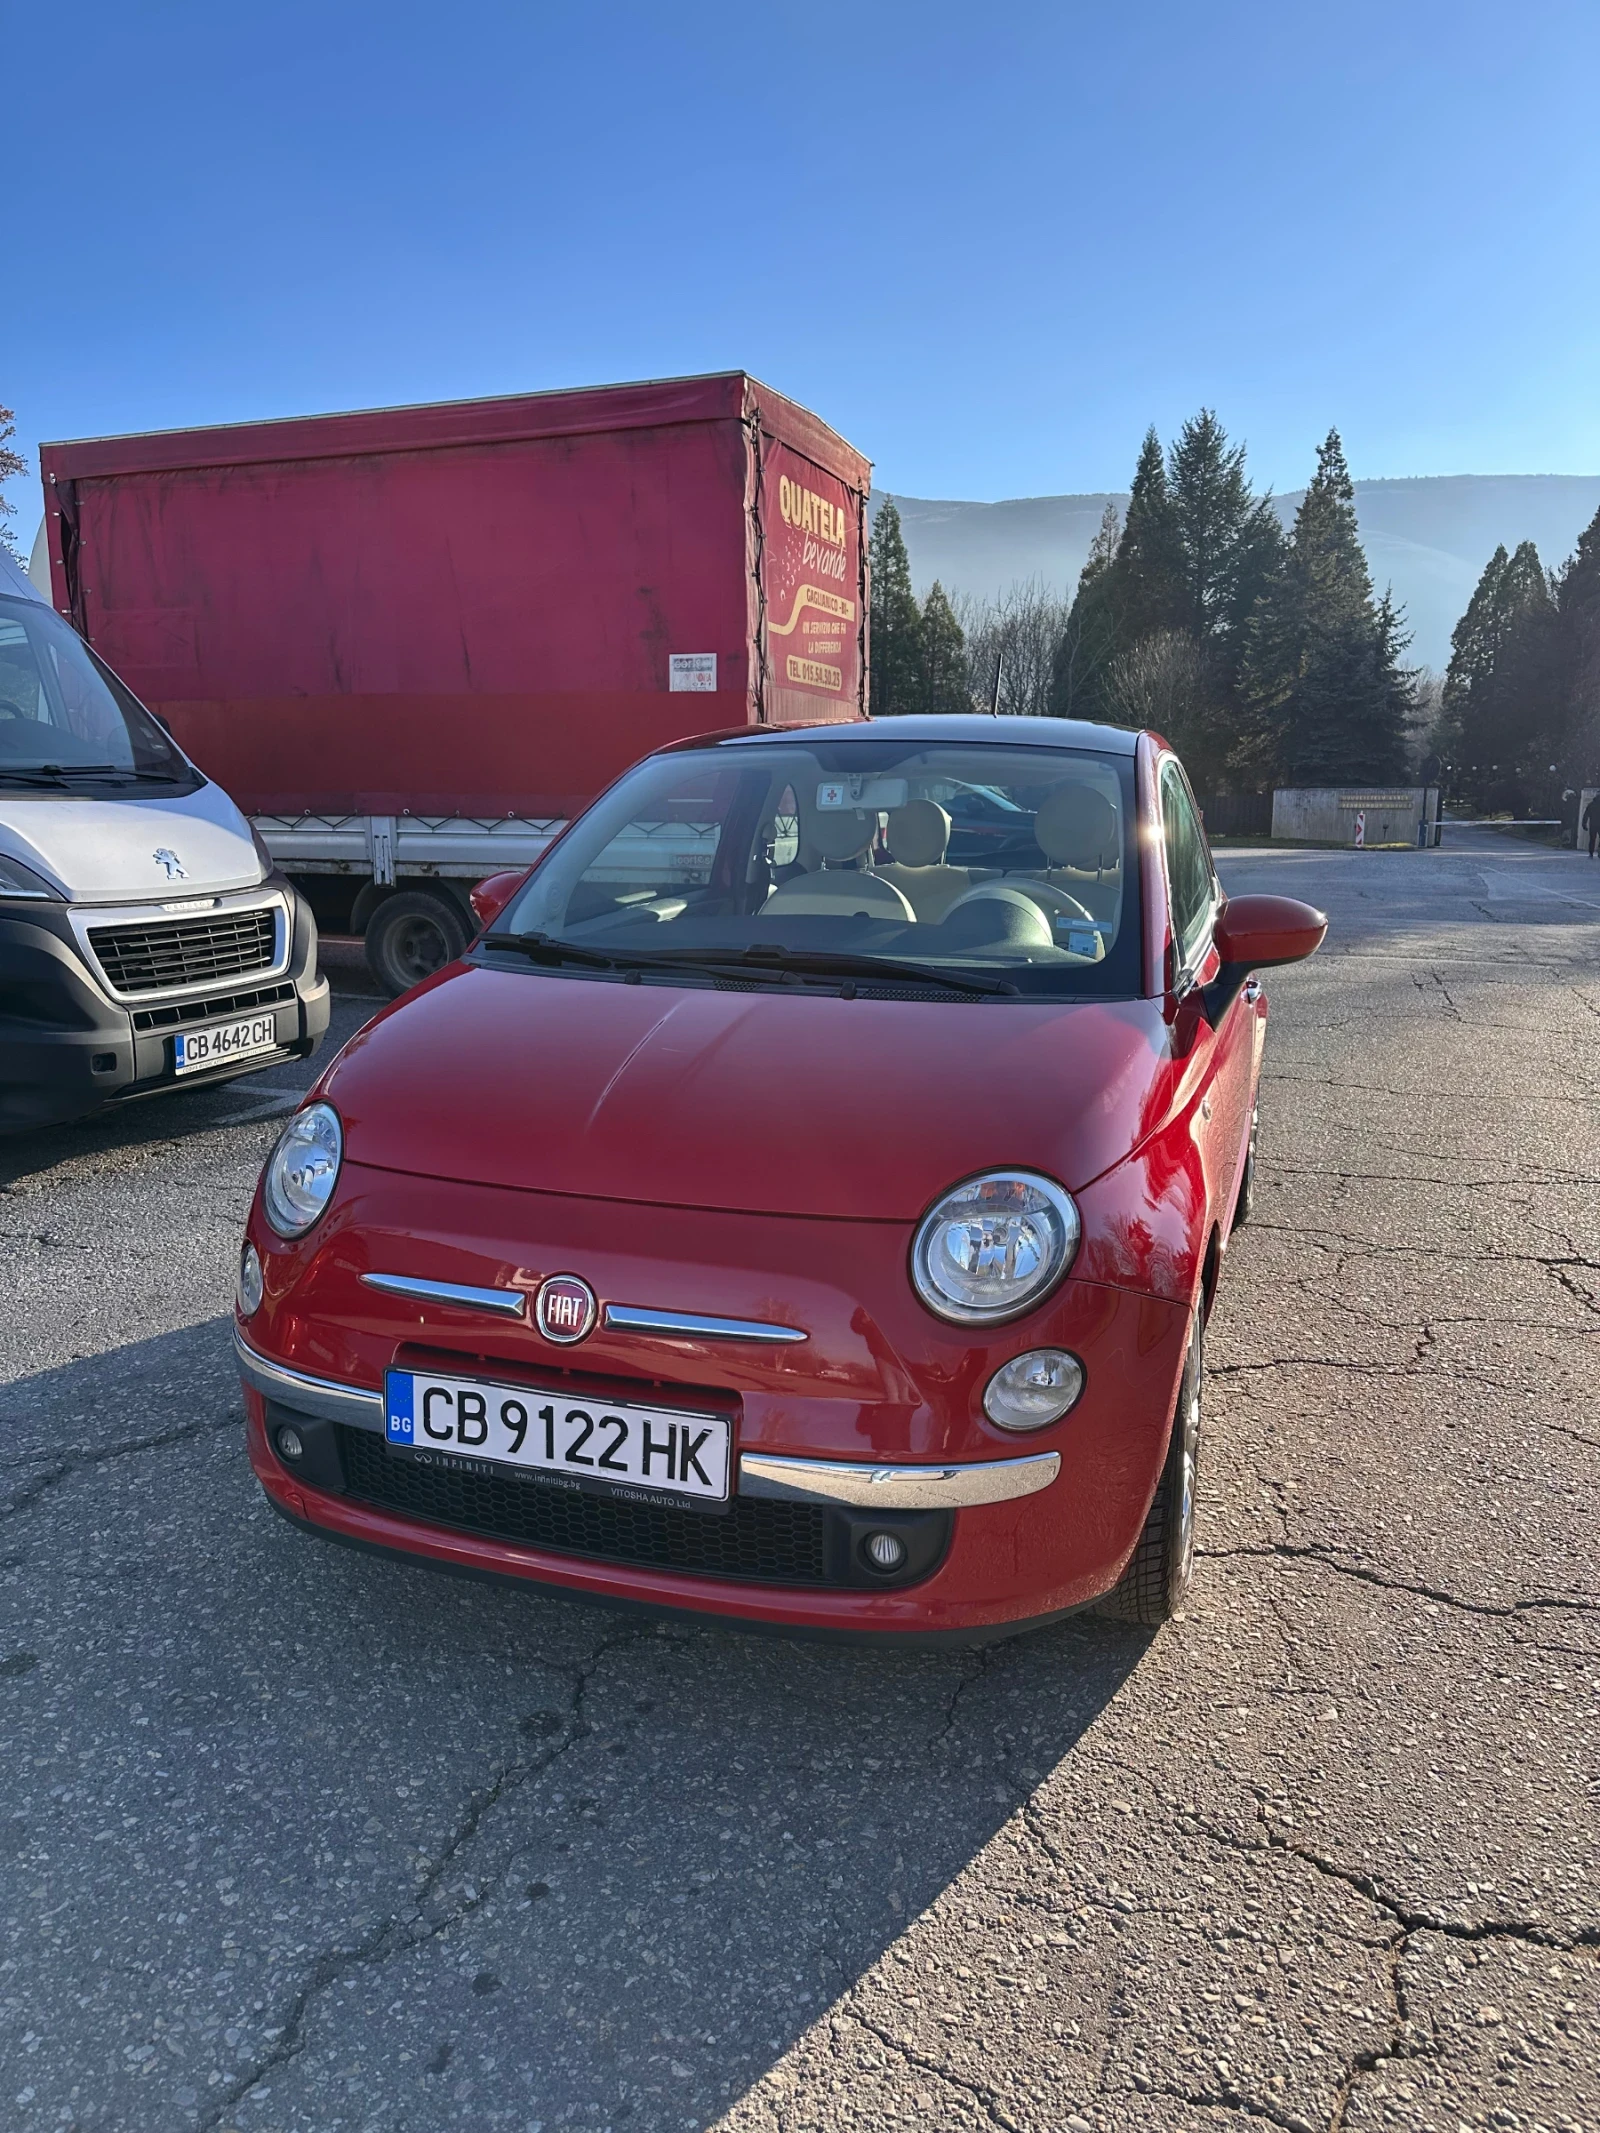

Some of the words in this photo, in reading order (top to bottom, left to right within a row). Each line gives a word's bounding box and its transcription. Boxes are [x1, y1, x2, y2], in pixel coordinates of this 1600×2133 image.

[779, 474, 846, 549] QUATELA
[803, 530, 847, 582] bevande
[808, 641, 814, 654] LA
[187, 1034, 209, 1060] CB
[212, 1025, 250, 1054] 4642
[253, 1019, 272, 1044] CH
[547, 1294, 583, 1328] FIAT
[390, 1415, 411, 1433] BG
[422, 1386, 489, 1446] CB
[500, 1399, 629, 1473] 9122
[641, 1419, 713, 1487] HK
[435, 1456, 494, 1475] INFINITI
[514, 1470, 581, 1491] www.infinitibg.bg
[611, 1487, 649, 1503] VITOSHA
[650, 1491, 675, 1507] AUTO
